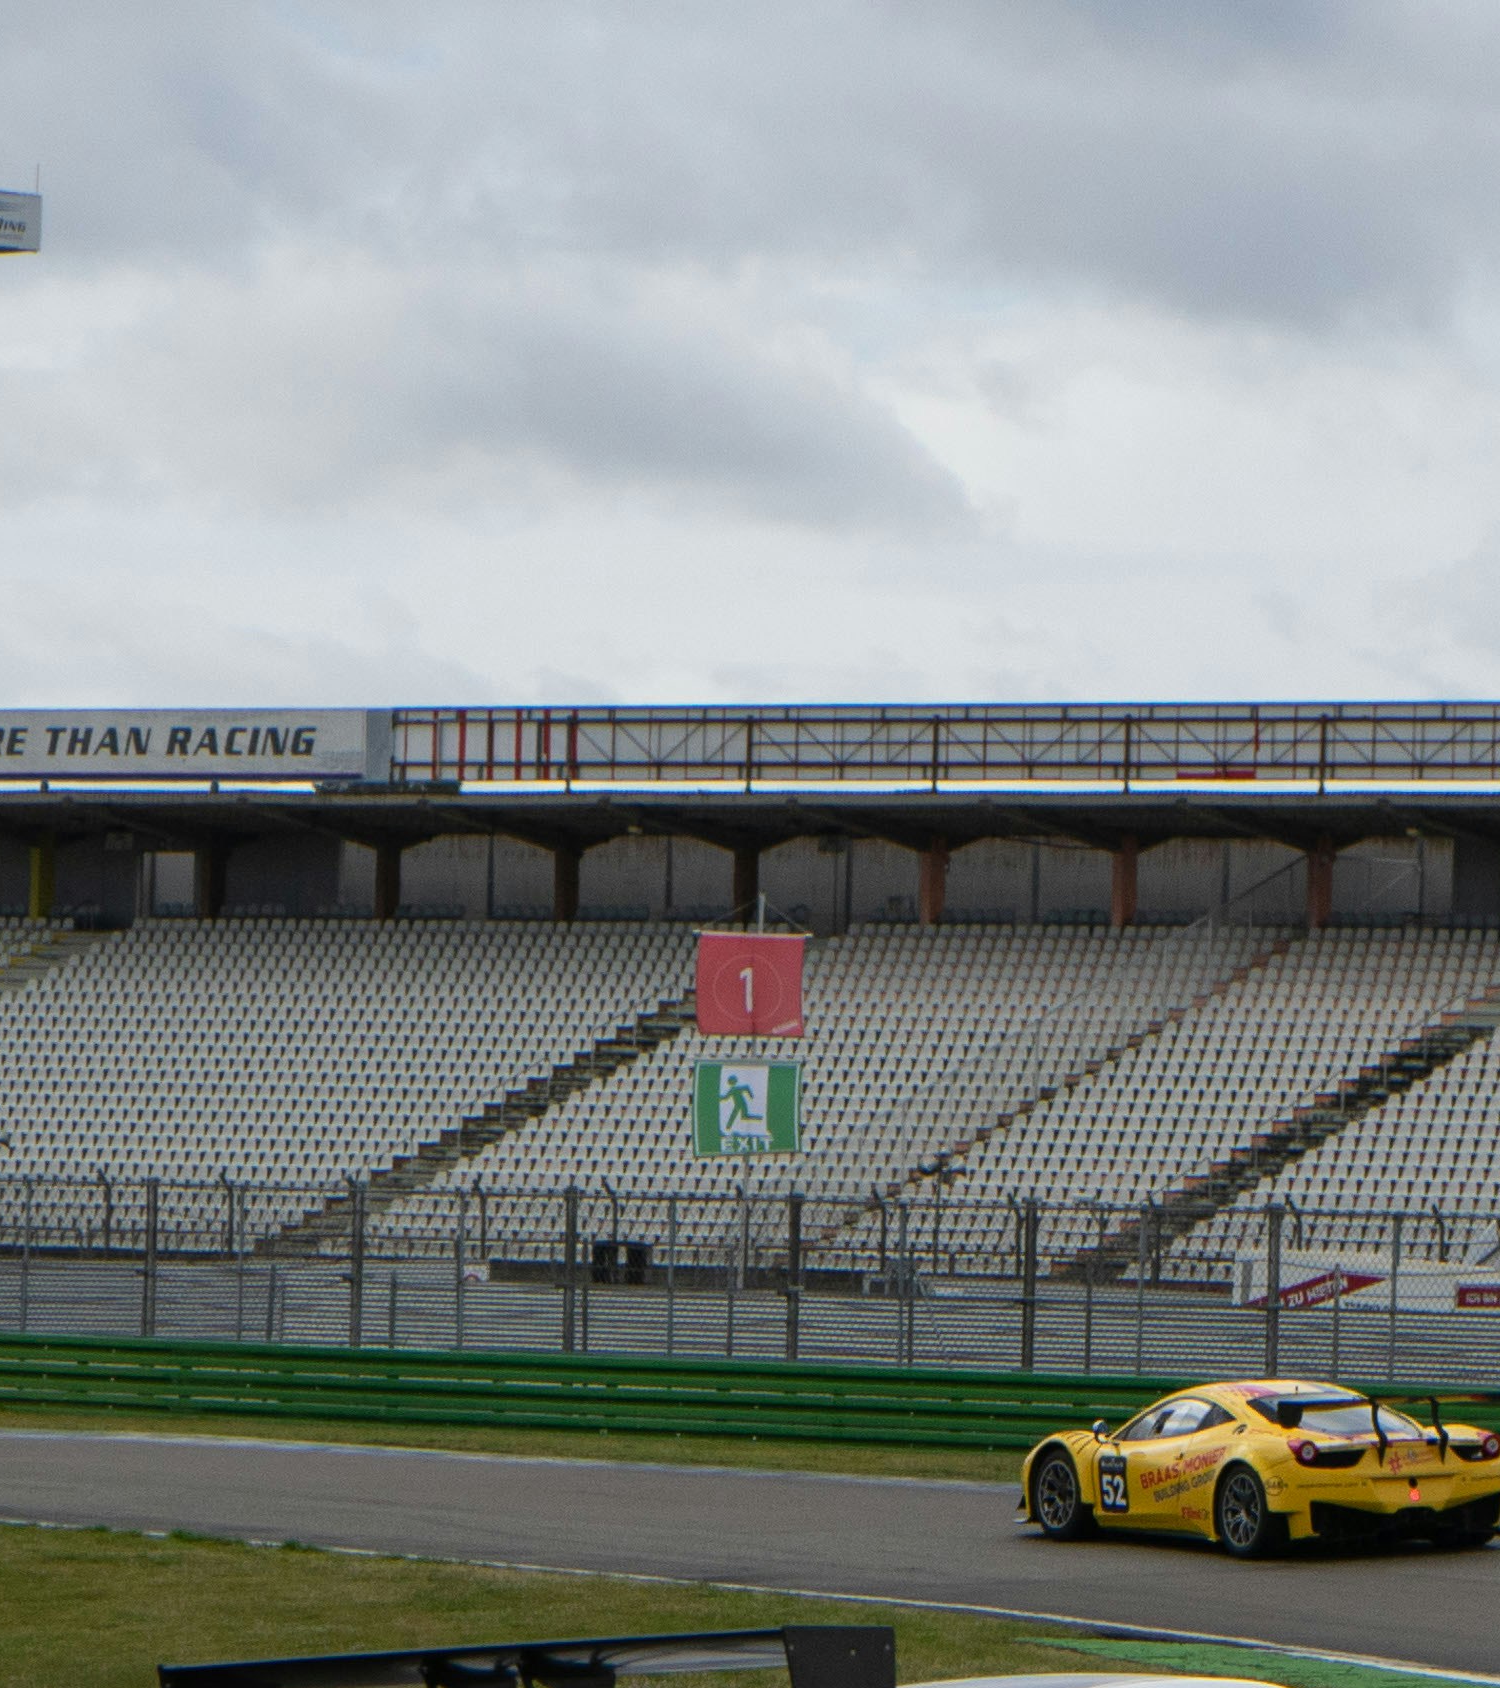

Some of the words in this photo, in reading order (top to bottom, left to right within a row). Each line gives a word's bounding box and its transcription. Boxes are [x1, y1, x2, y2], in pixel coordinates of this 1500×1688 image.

[46, 727, 152, 757] THAN
[165, 727, 317, 757] RACING
[739, 967, 753, 1014] 1
[720, 1136, 773, 1152] EXIT
[1102, 1474, 1127, 1507] 52
